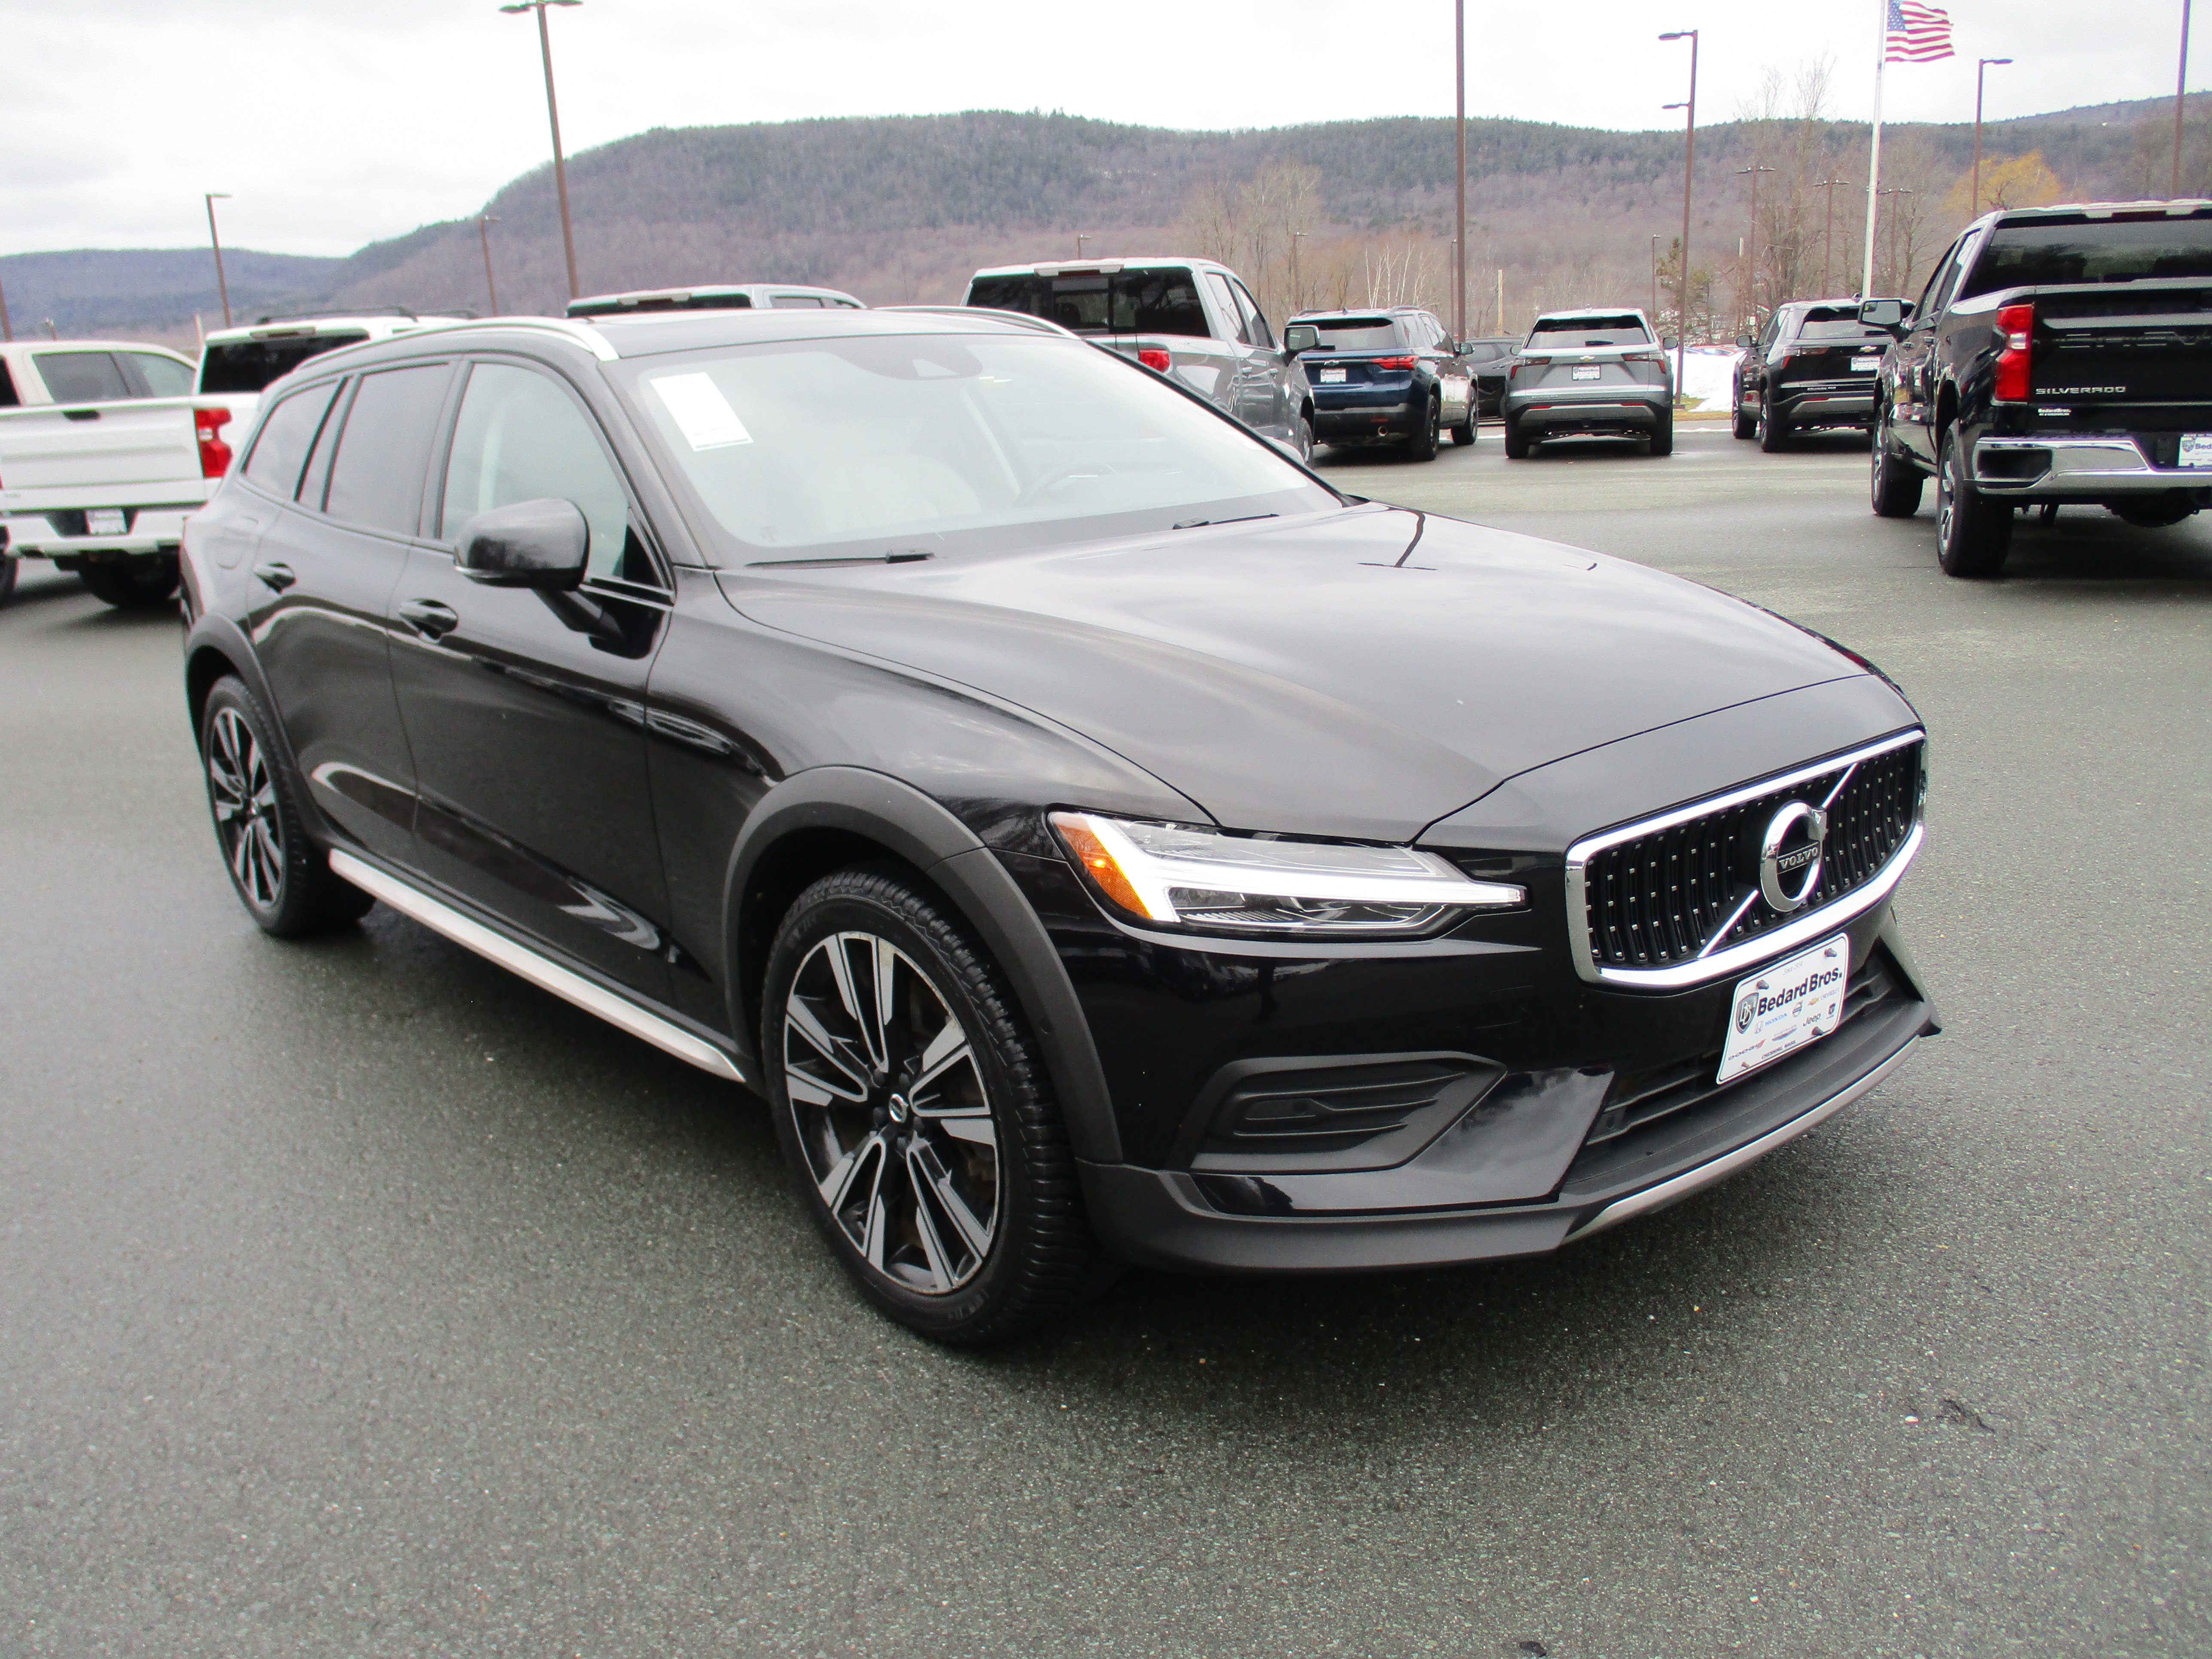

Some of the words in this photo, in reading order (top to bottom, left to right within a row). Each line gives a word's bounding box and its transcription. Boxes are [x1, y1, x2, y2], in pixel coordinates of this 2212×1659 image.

[2035, 386, 2127, 395] SILVERADO
[1778, 847, 1818, 869] VOLVO
[1757, 977, 1808, 1017] Bedard
[1808, 967, 1842, 992] Bros.
[1764, 1013, 1788, 1026] HONDA
[1802, 1013, 1822, 1027] Jeep
